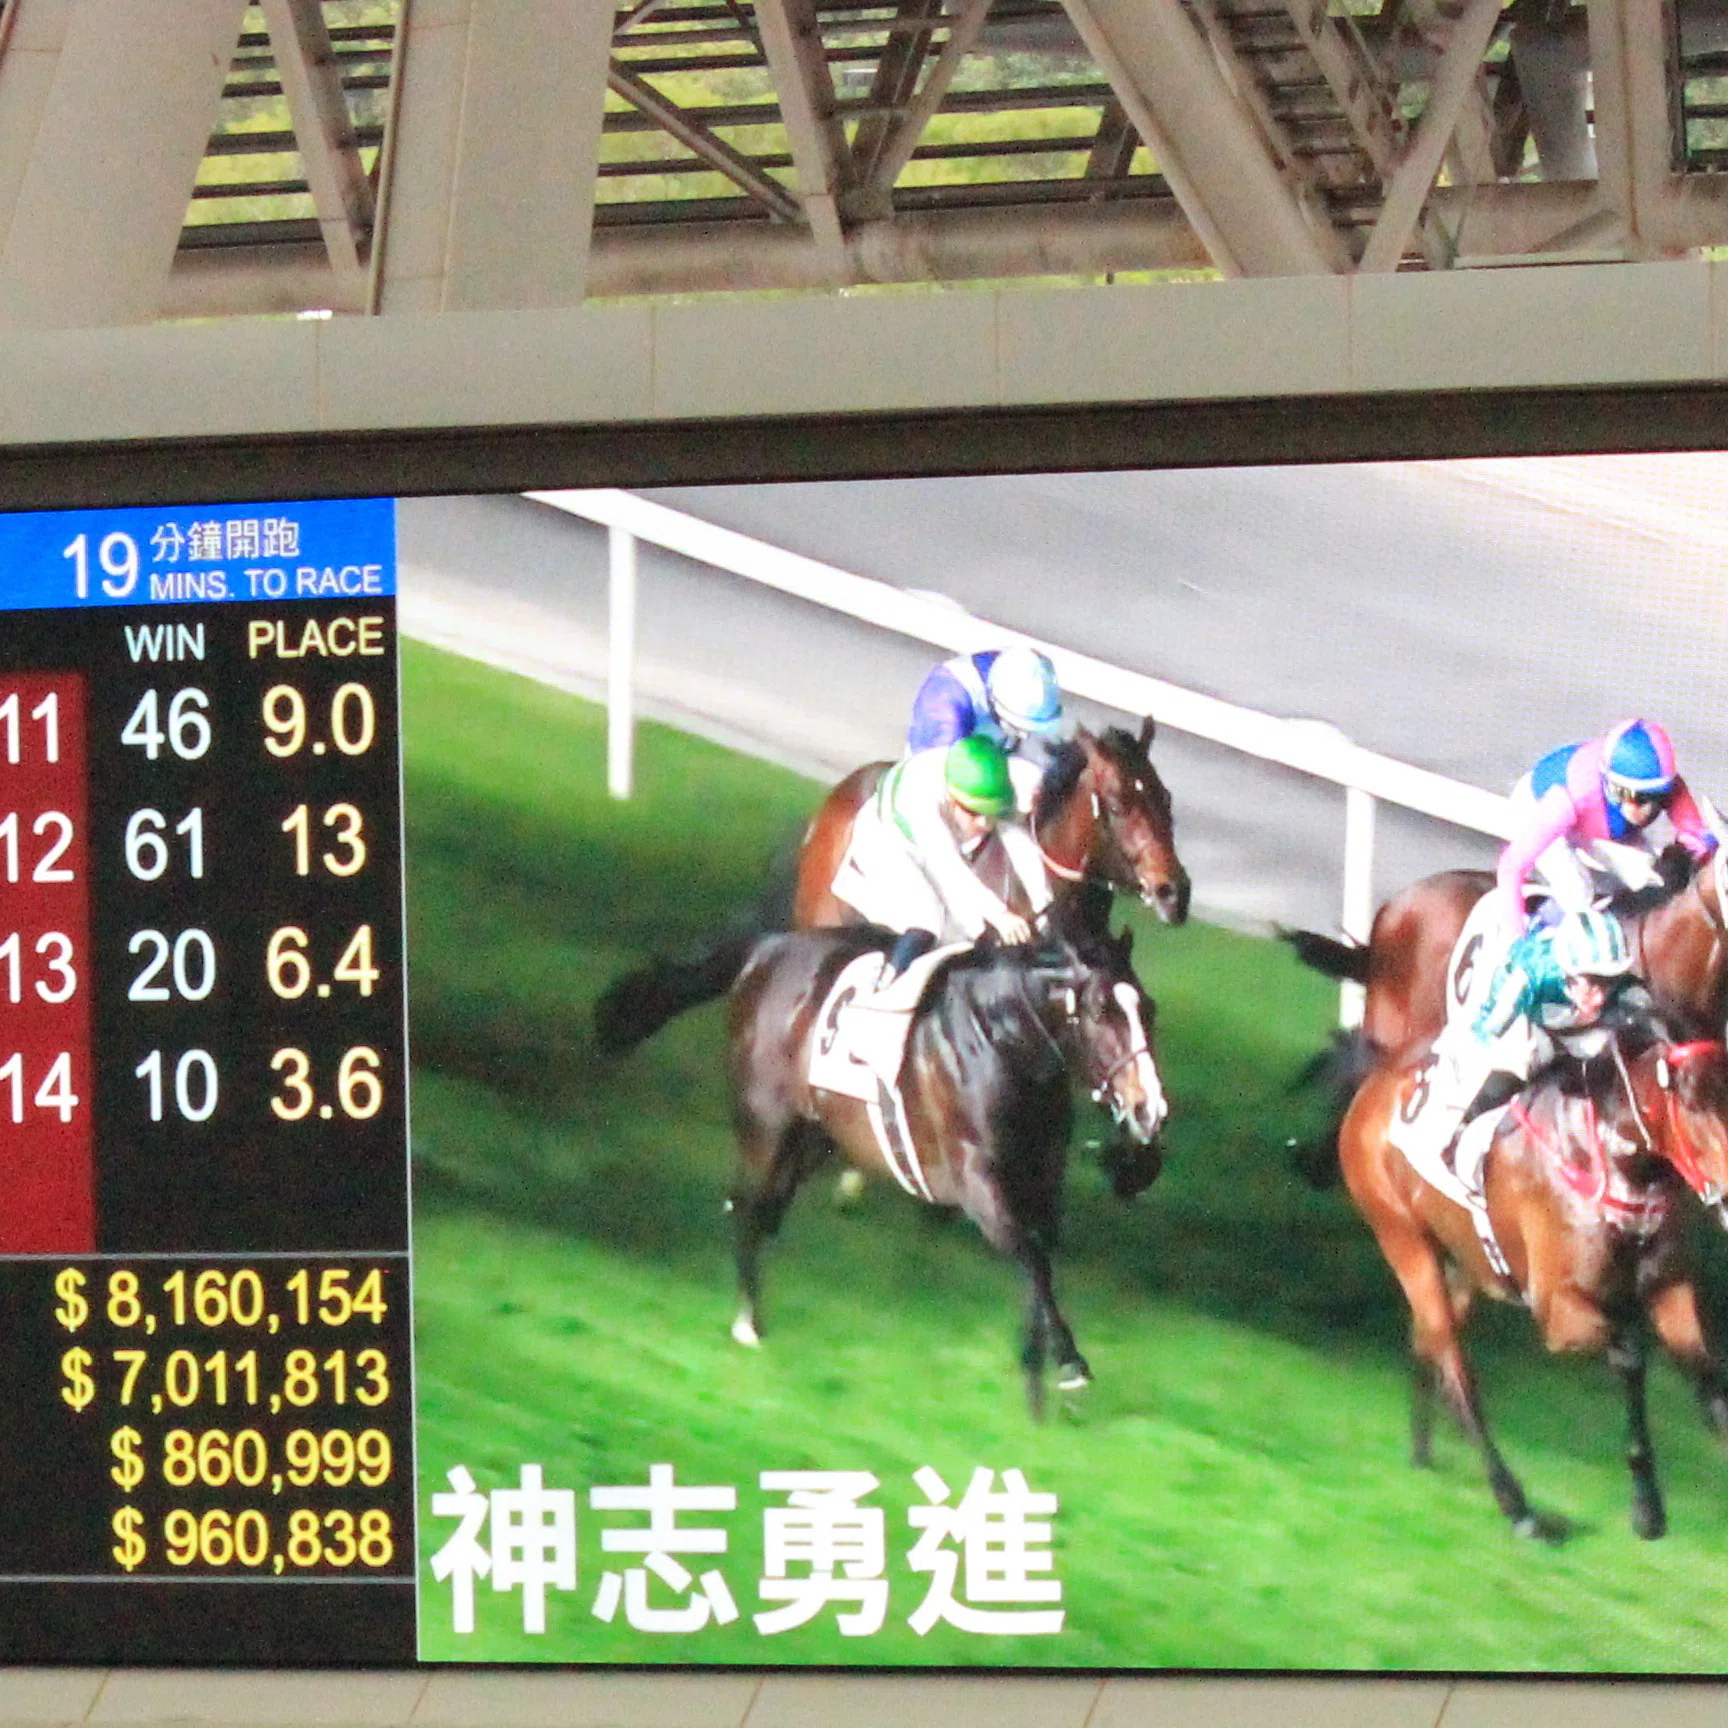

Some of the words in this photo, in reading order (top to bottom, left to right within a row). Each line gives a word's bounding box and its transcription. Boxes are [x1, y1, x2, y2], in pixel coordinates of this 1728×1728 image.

[62, 531, 141, 600] 19
[149, 516, 301, 564] 分鐘開跑
[149, 570, 236, 602] MINS.
[242, 568, 288, 599] TO
[295, 564, 383, 596] RACE
[124, 622, 205, 663] WIN
[248, 616, 385, 659] PLACE
[121, 687, 211, 760] 46
[262, 682, 375, 757] 9.0
[125, 807, 203, 881] 61
[281, 803, 366, 876] 13
[128, 928, 216, 1001] 20
[266, 924, 380, 999] 6.4
[135, 1049, 218, 1122] 10
[270, 1046, 382, 1121] 3.6
[430, 1463, 1065, 1636] 神志勇進
